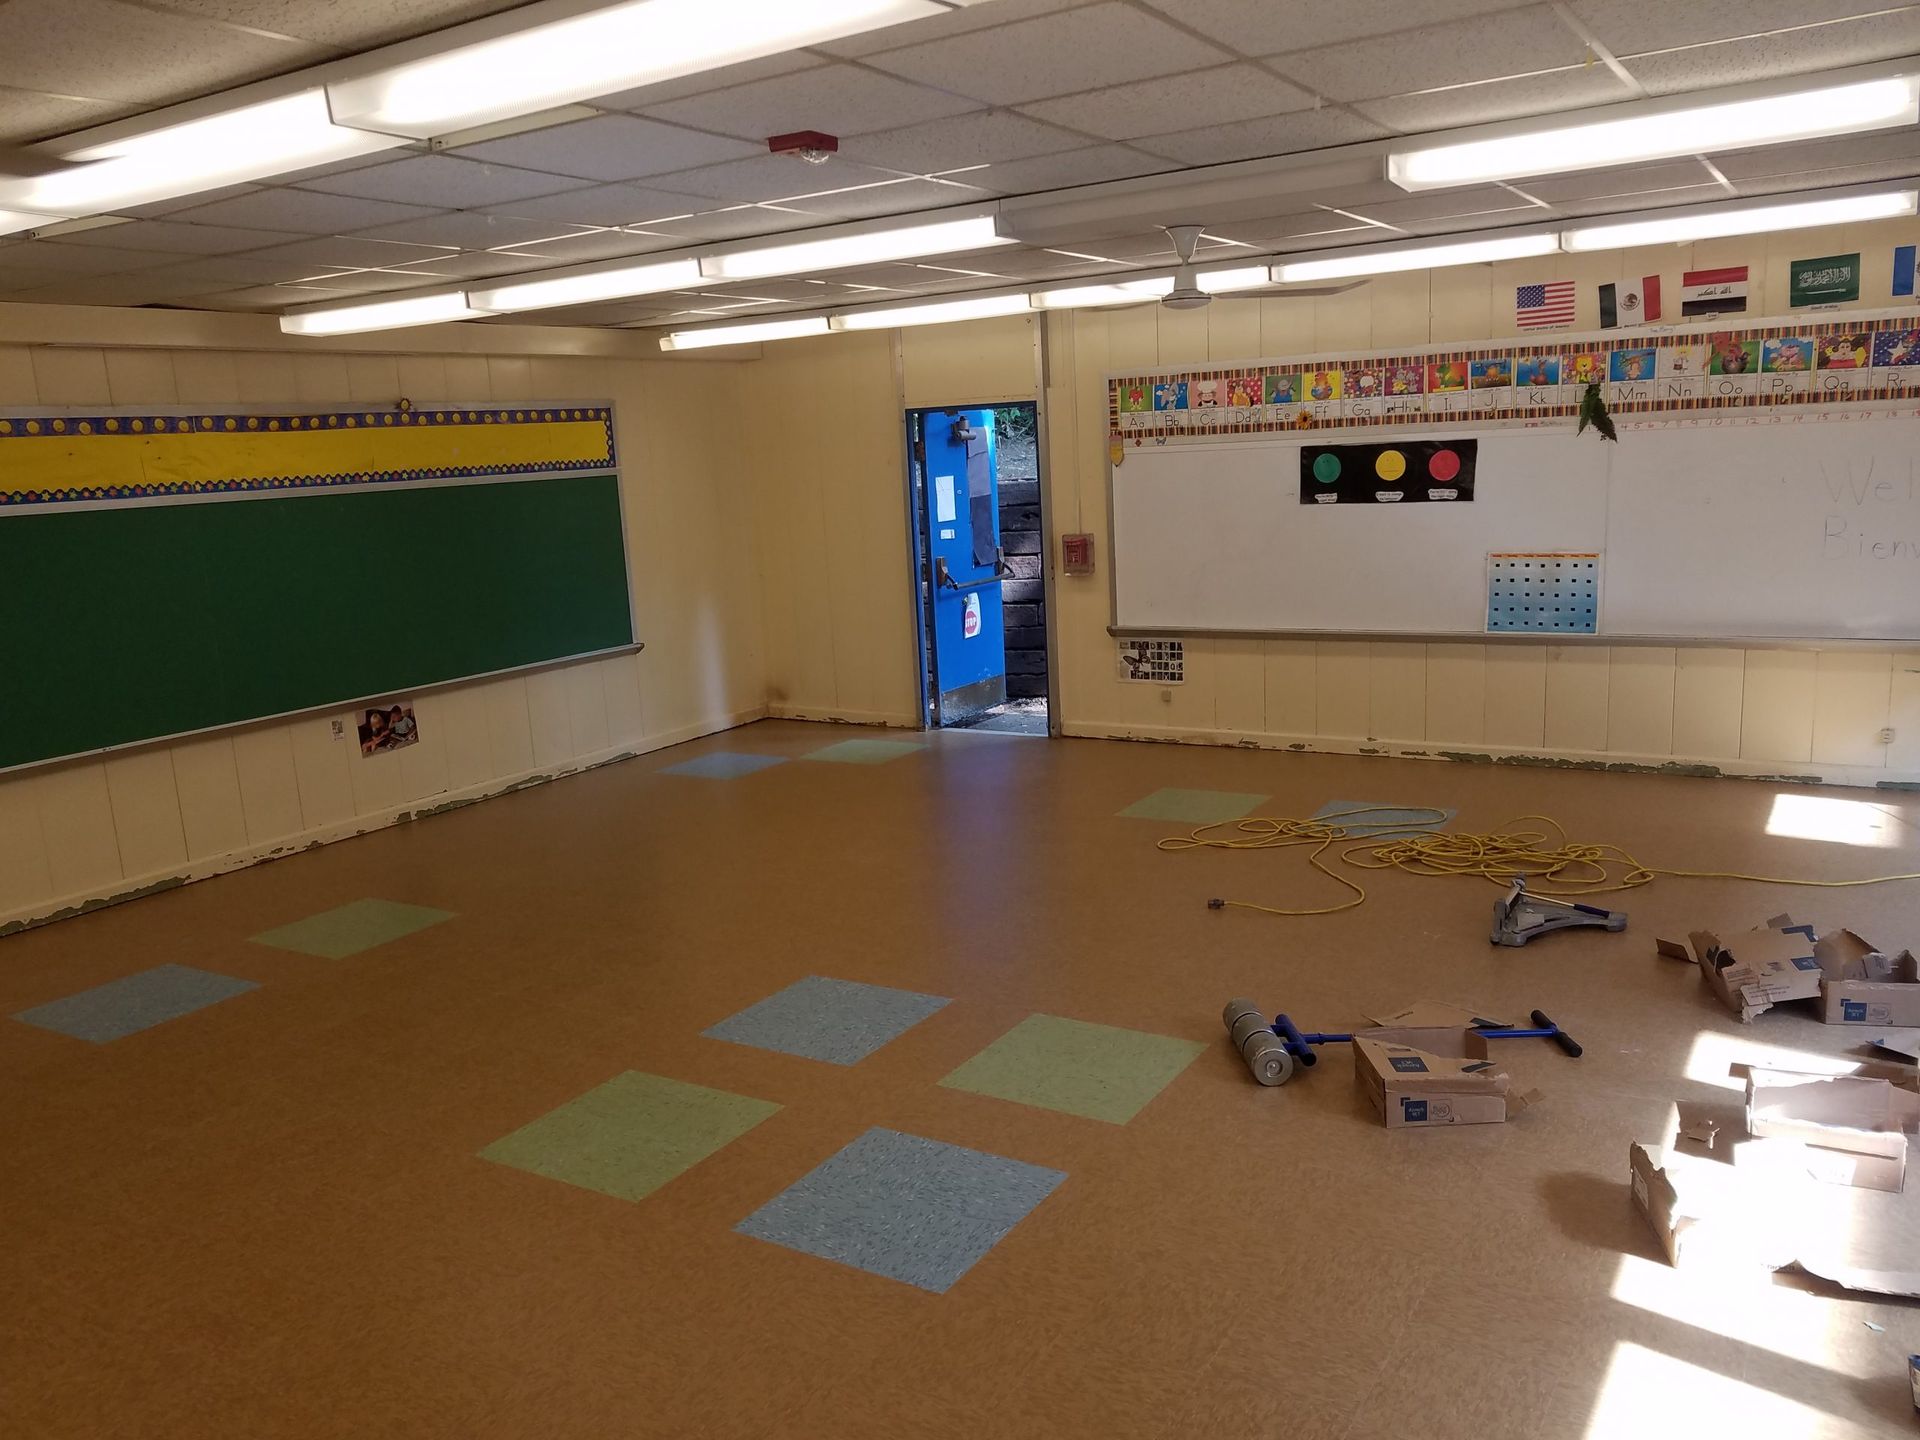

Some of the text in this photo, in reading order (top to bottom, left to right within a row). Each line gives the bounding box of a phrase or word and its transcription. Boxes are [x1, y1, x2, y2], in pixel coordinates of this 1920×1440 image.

[1772, 378, 1793, 394] Pp
[1887, 373, 1906, 388] Rr
[1618, 387, 1647, 400] Mm
[1668, 384, 1692, 397] Nn
[1719, 381, 1743, 395] Oo
[1529, 391, 1546, 404] Kk
[1235, 411, 1251, 423] Dd
[1276, 409, 1291, 421] Ee
[1315, 405, 1329, 417] Ff
[1129, 416, 1145, 428] Aa
[1165, 415, 1180, 427] Bb
[1200, 413, 1216, 425] Cc
[965, 617, 977, 628] STOP
